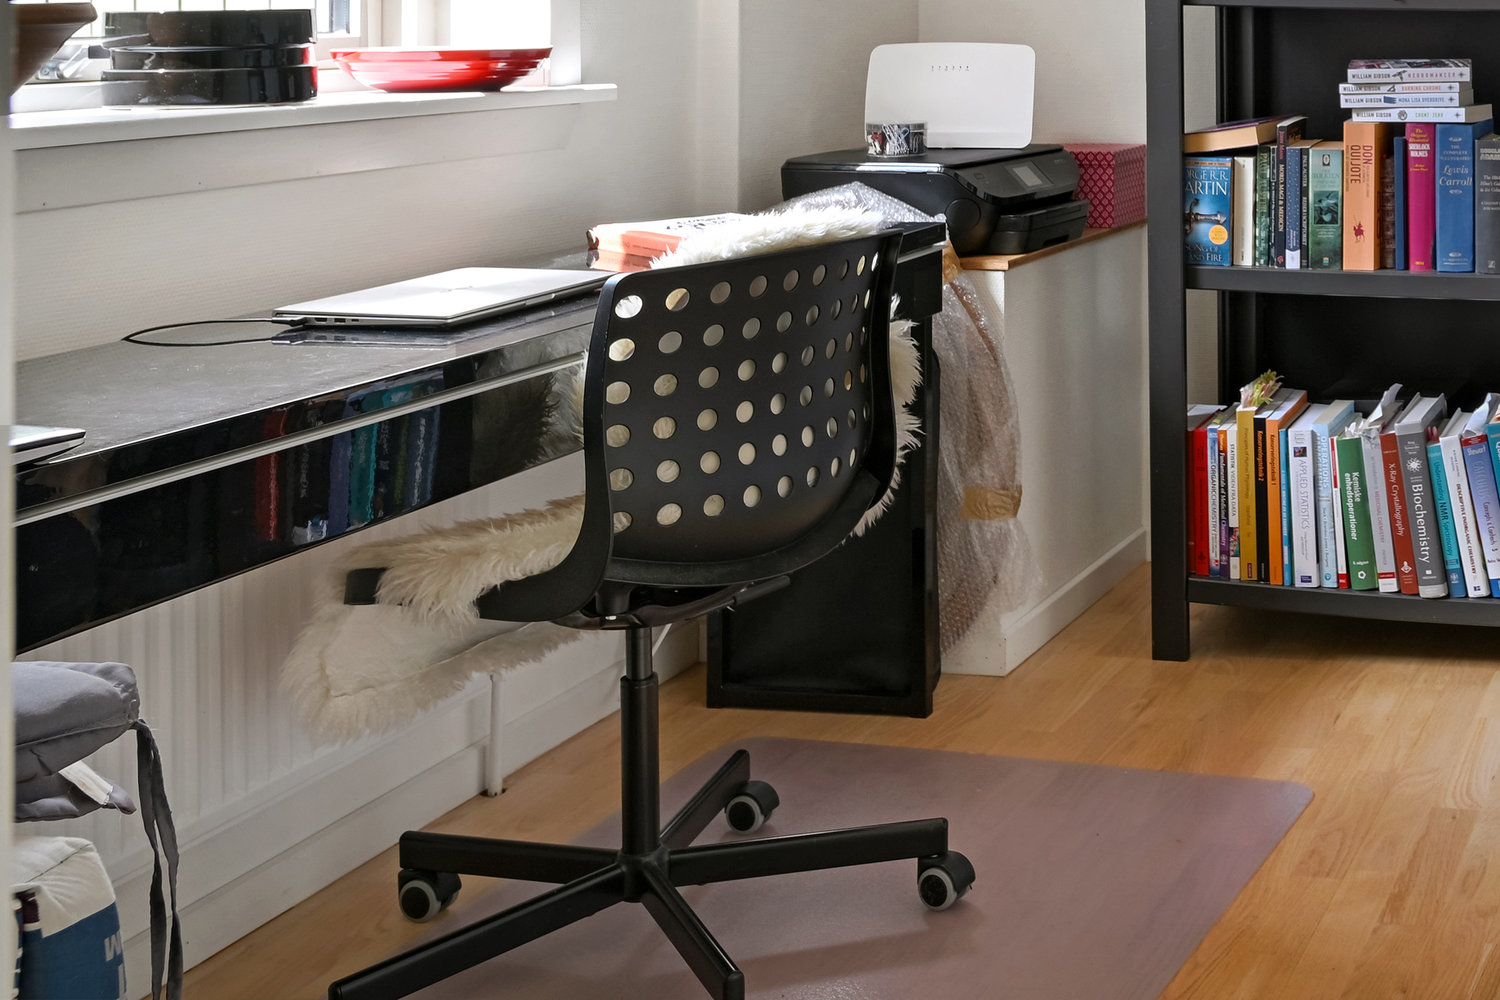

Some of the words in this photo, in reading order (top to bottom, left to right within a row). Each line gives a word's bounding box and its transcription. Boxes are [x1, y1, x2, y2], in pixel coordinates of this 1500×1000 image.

[1350, 145, 1361, 184] QUIJOTE
[1362, 145, 1373, 165] DON
[1444, 165, 1468, 175] Lewis
[1439, 177, 1472, 186] Carroll
[1256, 430, 1264, 477] Konserveringsteknik
[1321, 436, 1329, 488] OPERATIONS
[1389, 463, 1397, 483] X-Ray
[1298, 460, 1308, 488] APPLIED
[1351, 472, 1361, 502] Kemiske
[1434, 461, 1446, 501] Understanding
[1300, 490, 1310, 530] STATISTICS
[1344, 473, 1358, 540] enhedsoperationer
[1391, 484, 1405, 536] Crystallography
[1411, 484, 1431, 563] Biochemistry
[1439, 502, 1448, 520] NMR
[1442, 521, 1453, 556] Spectroscopy
[1456, 484, 1466, 516] DESCRIPTIVE
[1462, 516, 1471, 544] INORGANIC
[1467, 546, 1476, 574] CHEMISTRY
